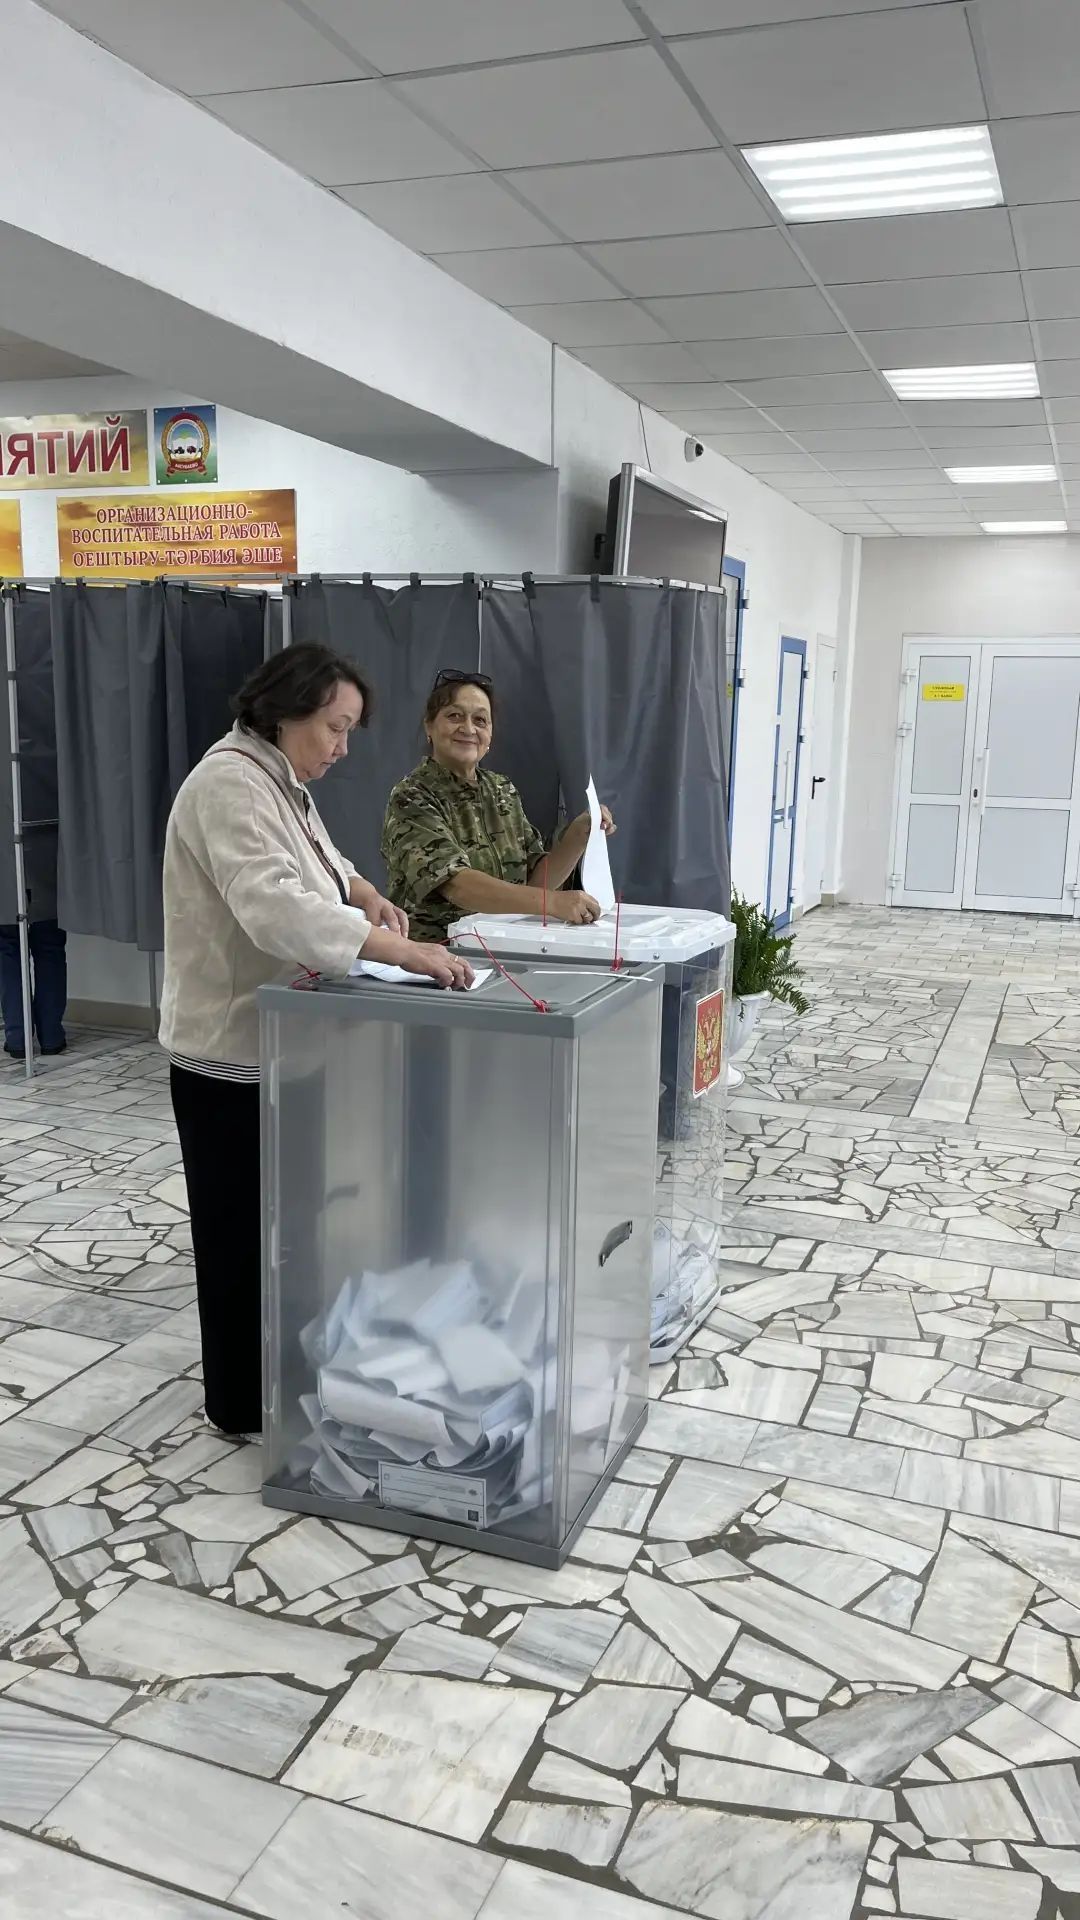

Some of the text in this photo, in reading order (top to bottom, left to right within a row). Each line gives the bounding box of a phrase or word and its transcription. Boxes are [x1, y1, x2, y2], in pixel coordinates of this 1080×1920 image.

[0, 415, 131, 476] ЯТИЙ
[96, 503, 253, 524] ОРГАНИЗАЦИОННО-
[71, 522, 281, 544] ВОСПИТАТЕЛЬНАЯ РАБОТА
[73, 547, 282, 567] ОЕШТЫРУ-ТӘРБИЯ ЭШЕ
